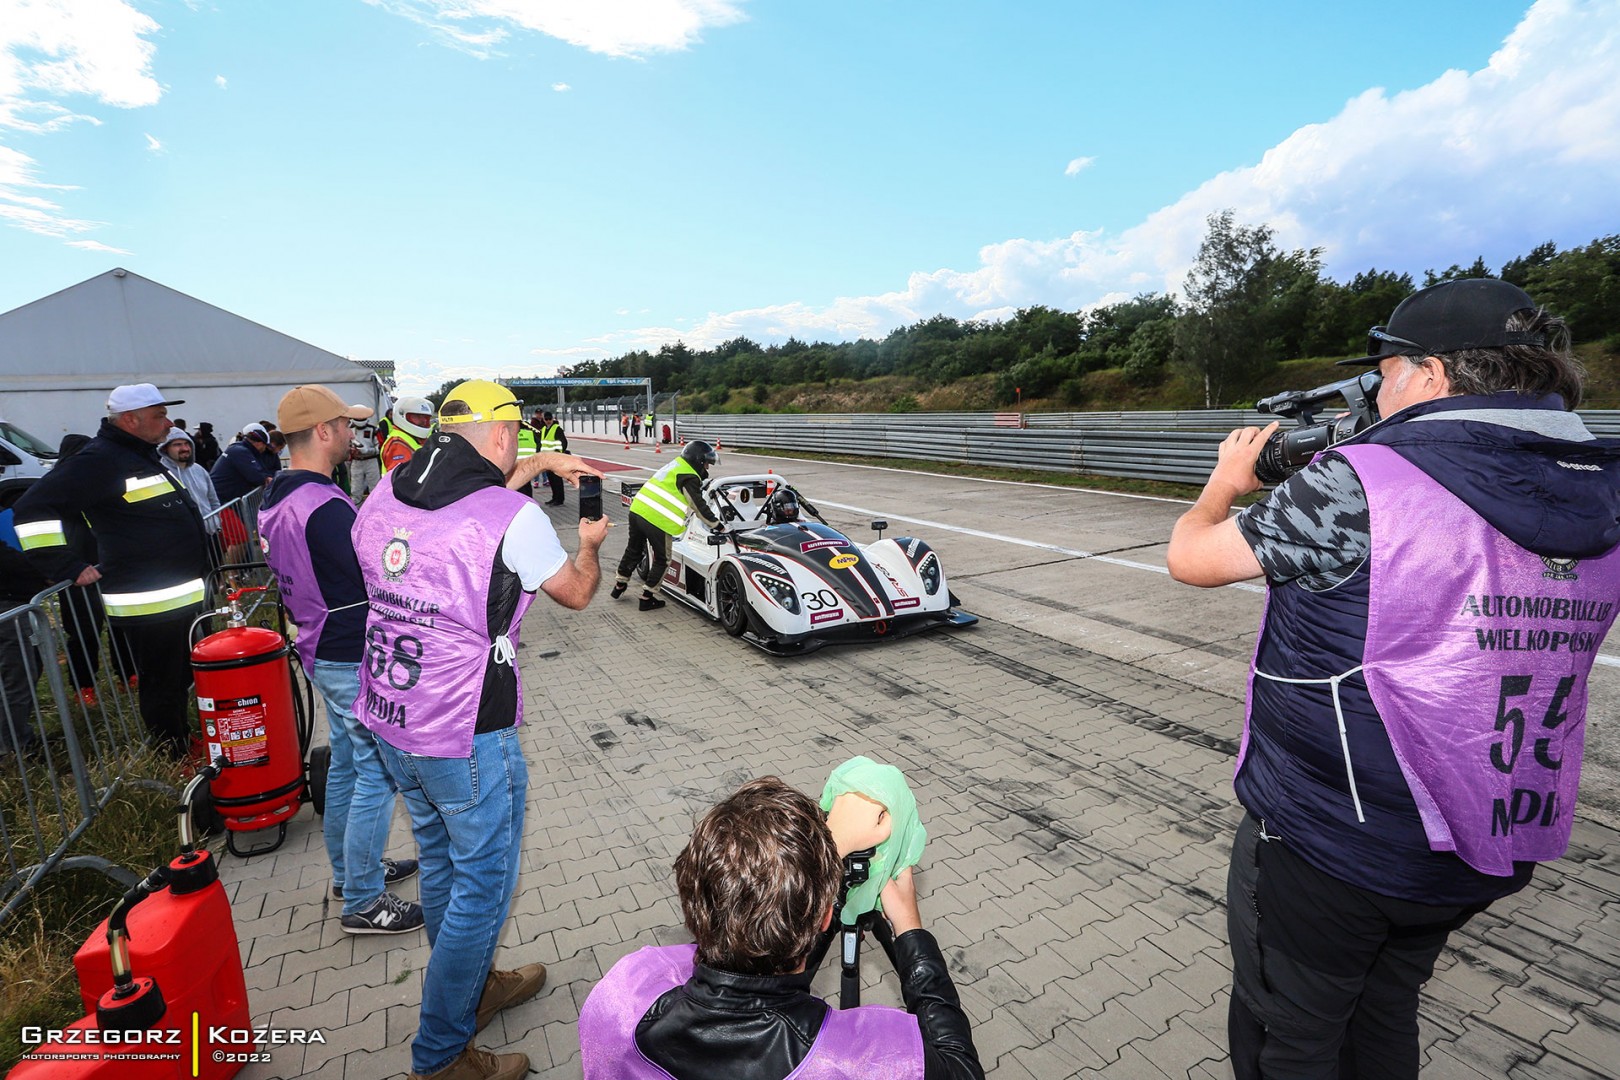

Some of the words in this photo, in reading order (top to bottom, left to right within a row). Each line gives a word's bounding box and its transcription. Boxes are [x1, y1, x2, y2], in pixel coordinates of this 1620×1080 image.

[801, 589, 839, 611] 30
[1460, 594, 1613, 622] AUTOMOBILKLUB
[366, 625, 423, 691] 68
[366, 685, 406, 729] MEDIA
